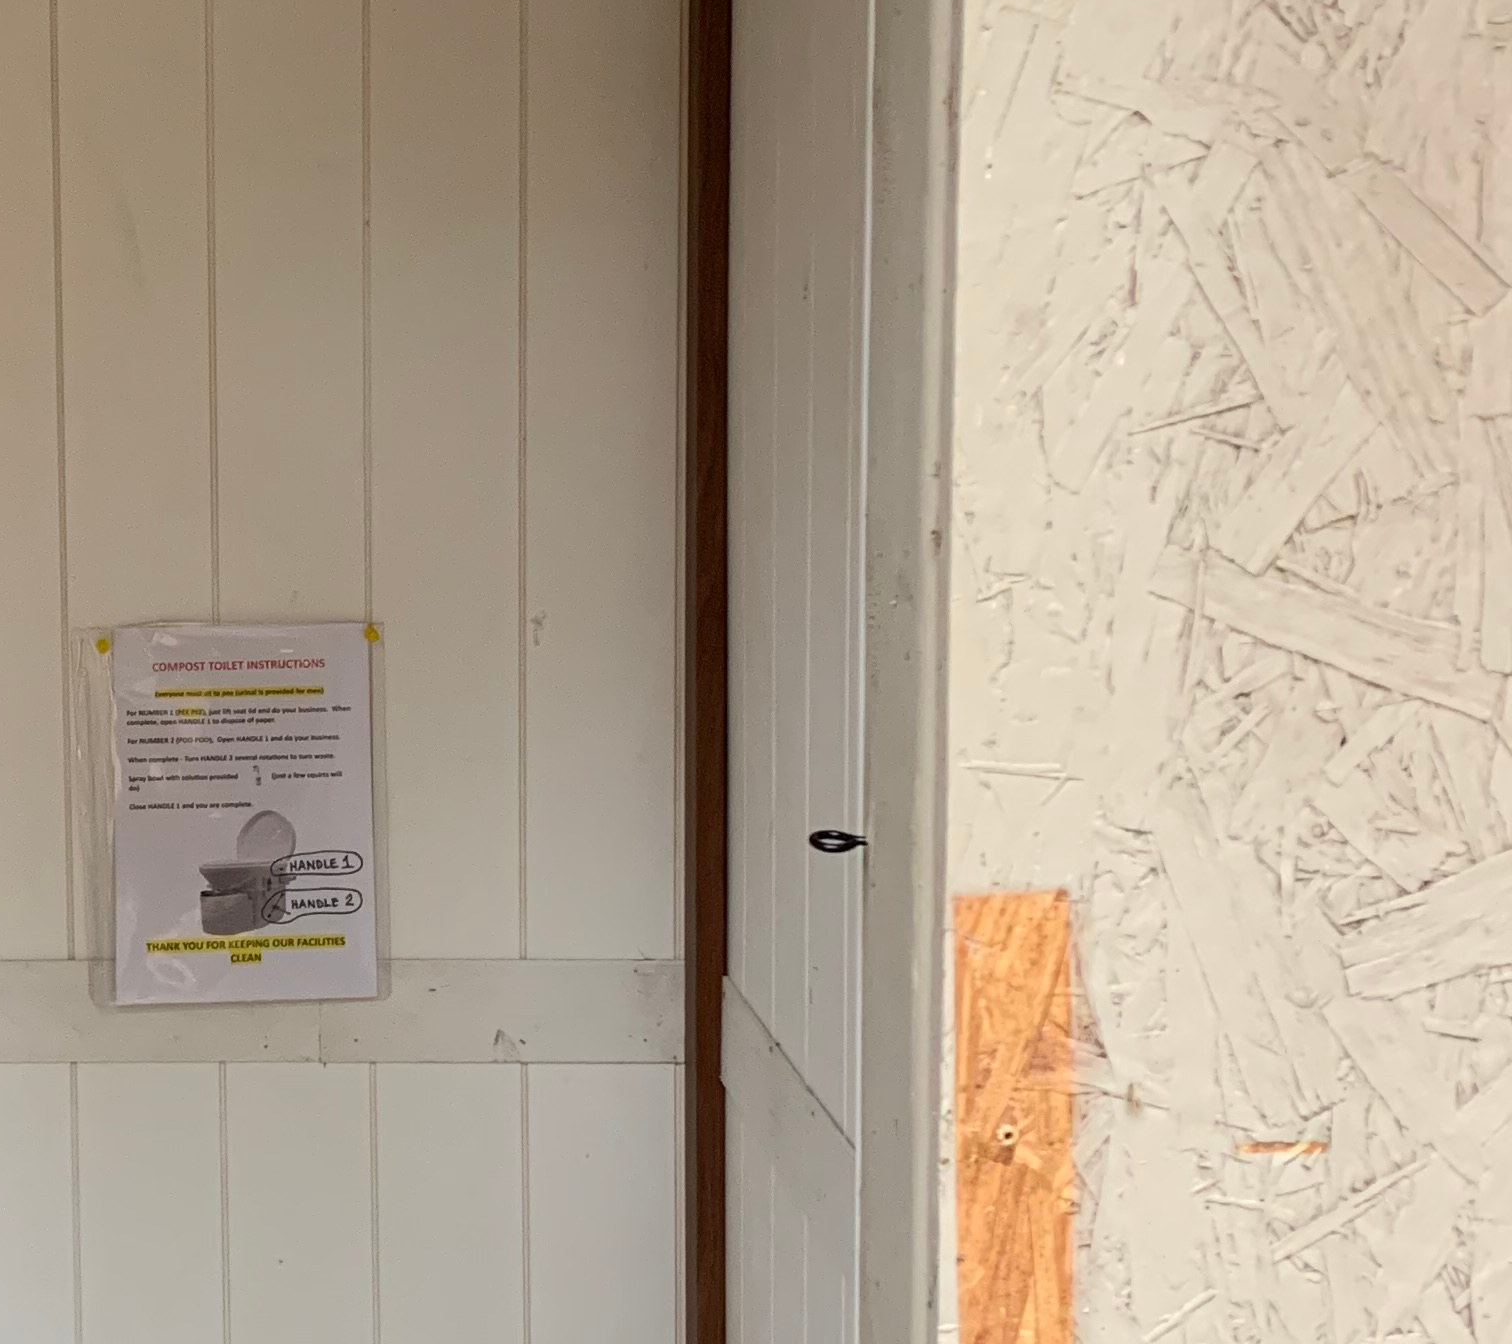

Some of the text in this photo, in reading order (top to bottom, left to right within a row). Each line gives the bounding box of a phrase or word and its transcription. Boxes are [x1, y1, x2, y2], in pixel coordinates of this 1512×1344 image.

[152, 658, 326, 672] COMPOST TOILET INSTRUCTIONS
[265, 688, 295, 696] provided
[208, 708, 221, 716] just
[128, 775, 146, 783] Spray
[209, 773, 239, 781] provided
[271, 772, 287, 780] (just
[307, 771, 329, 779] squirts
[290, 855, 355, 871] HANDLE 1
[291, 893, 354, 909] HANDLE 2
[147, 937, 346, 951] THANK YOU FOR KEEPING OUR FACILITIES
[231, 954, 262, 963] CLEAN
